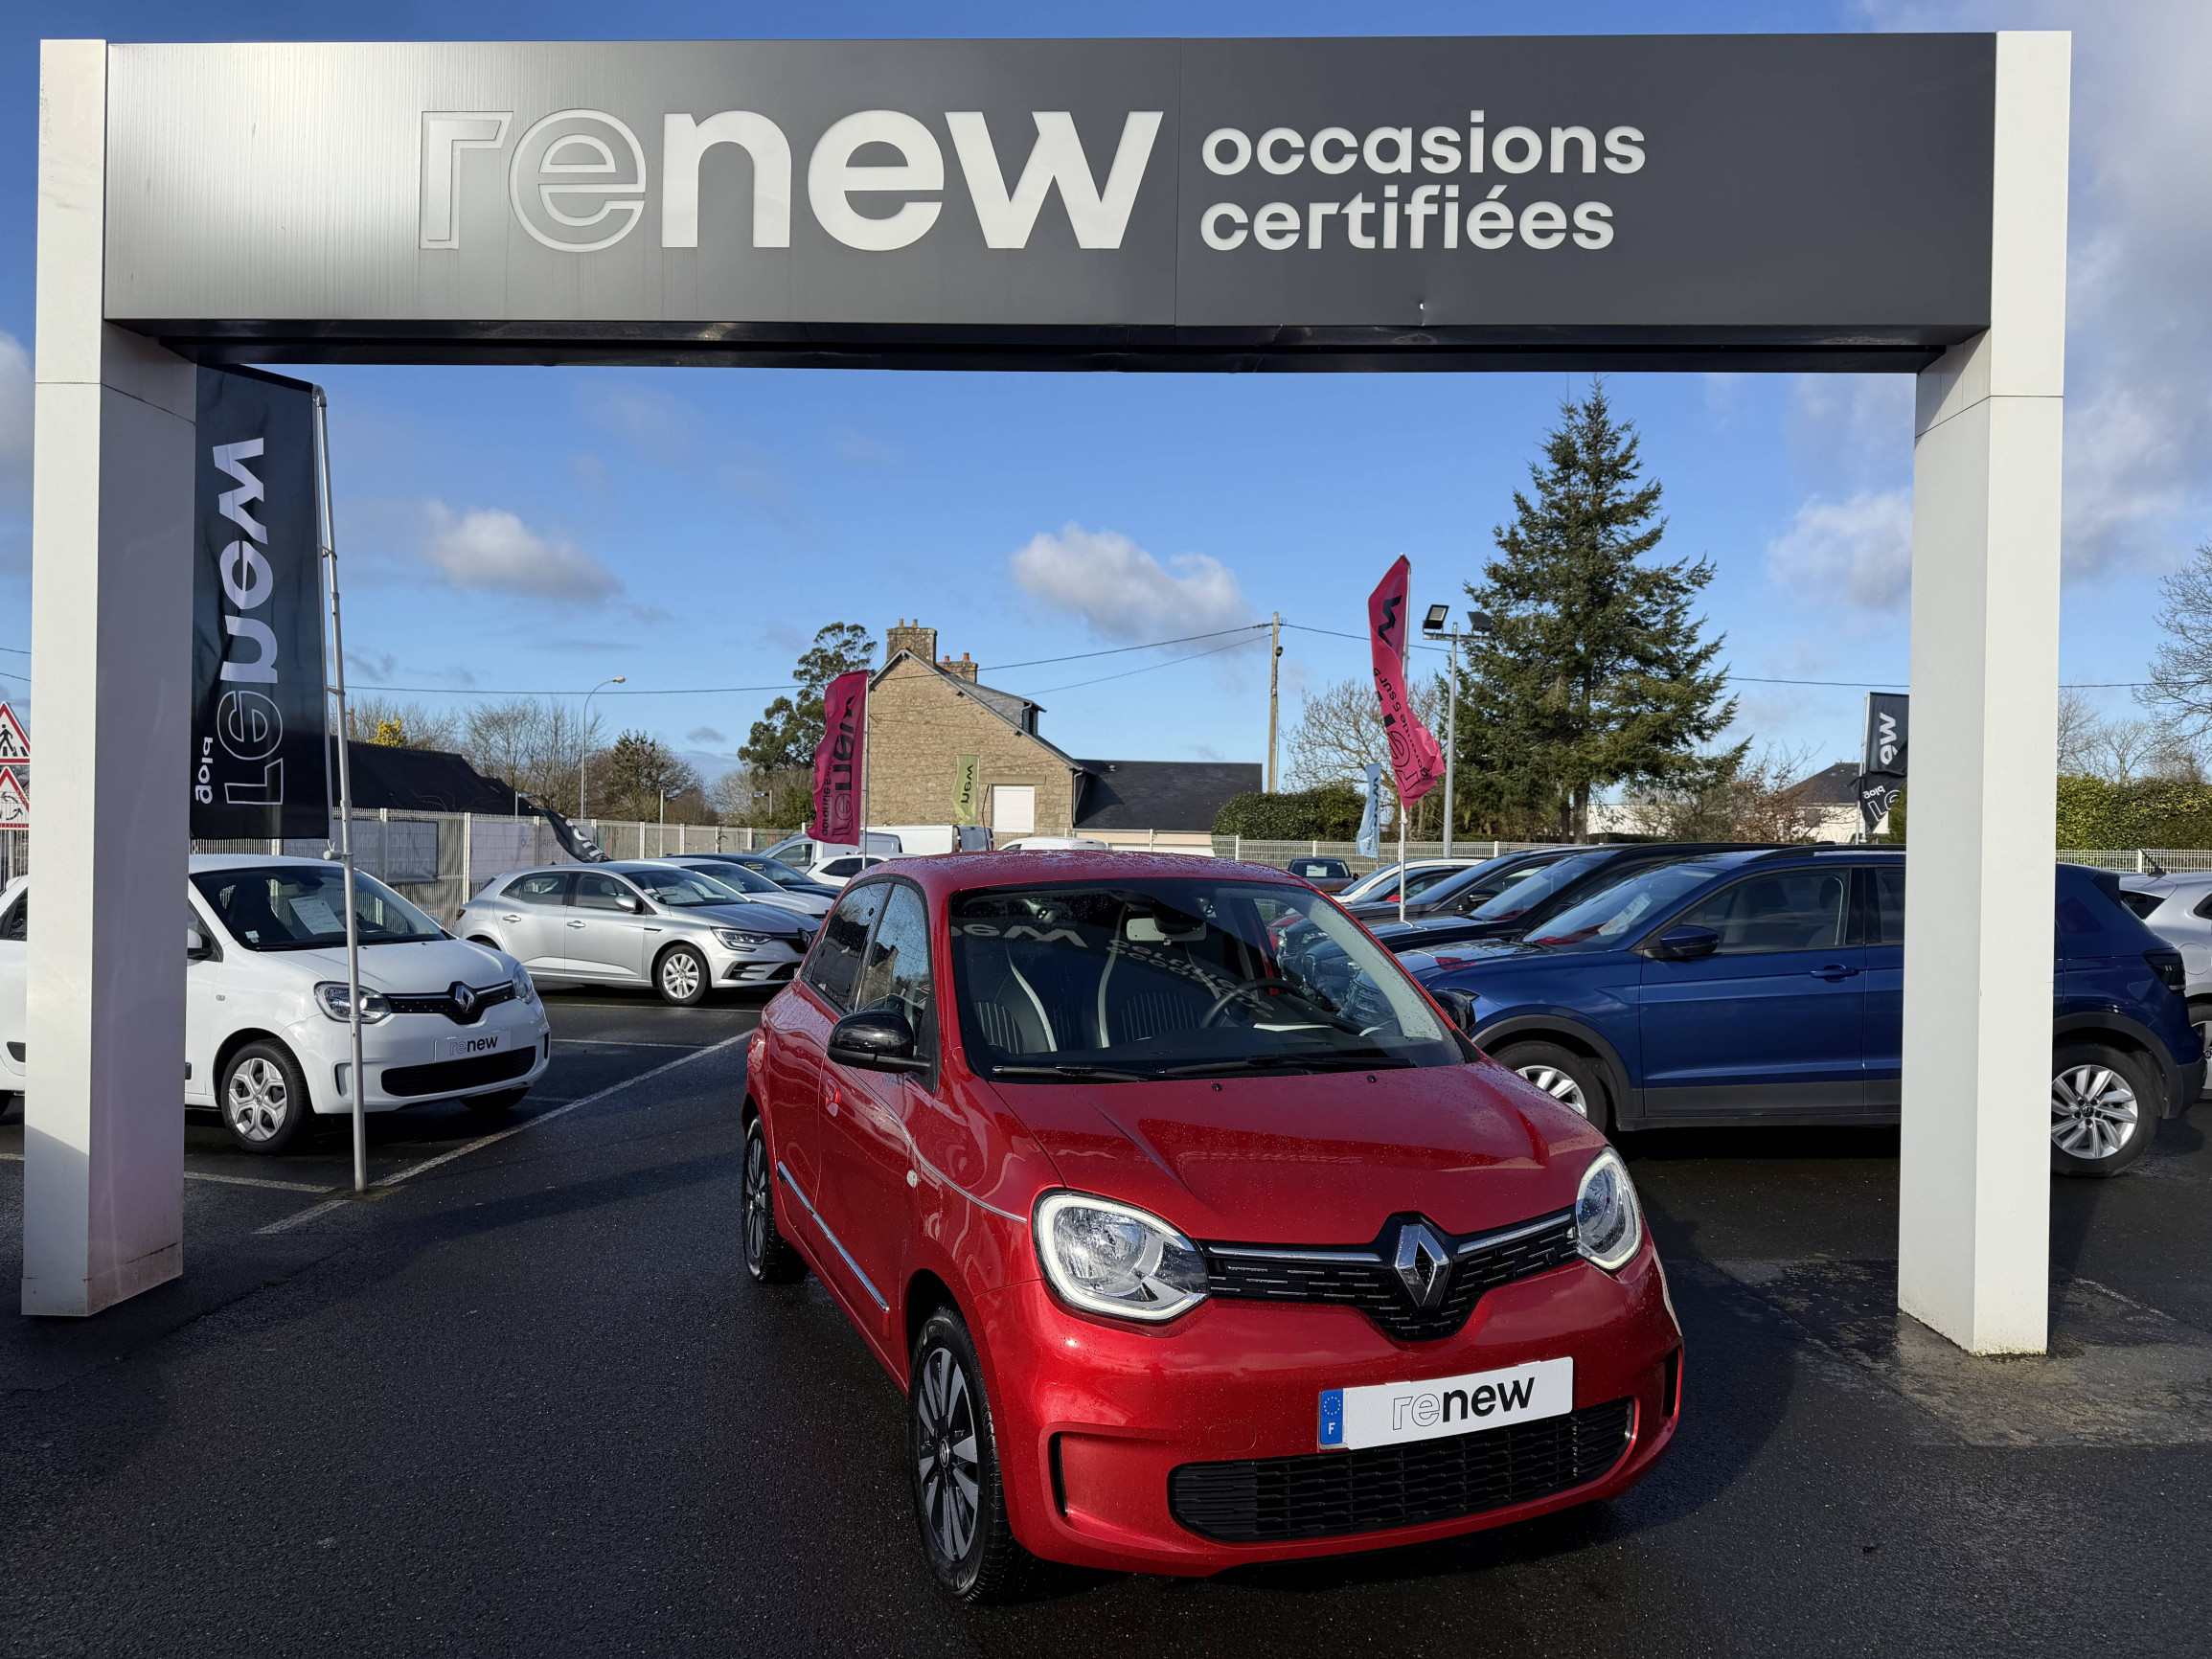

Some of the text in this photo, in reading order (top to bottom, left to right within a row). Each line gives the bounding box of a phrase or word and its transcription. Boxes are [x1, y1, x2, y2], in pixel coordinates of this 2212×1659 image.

[1201, 109, 1646, 176] occasions
[419, 108, 1164, 253] renew
[1199, 183, 1615, 251] certifiées
[449, 1036, 498, 1056] renew
[1328, 1422, 1336, 1435] F
[1392, 1376, 1536, 1431] renew
